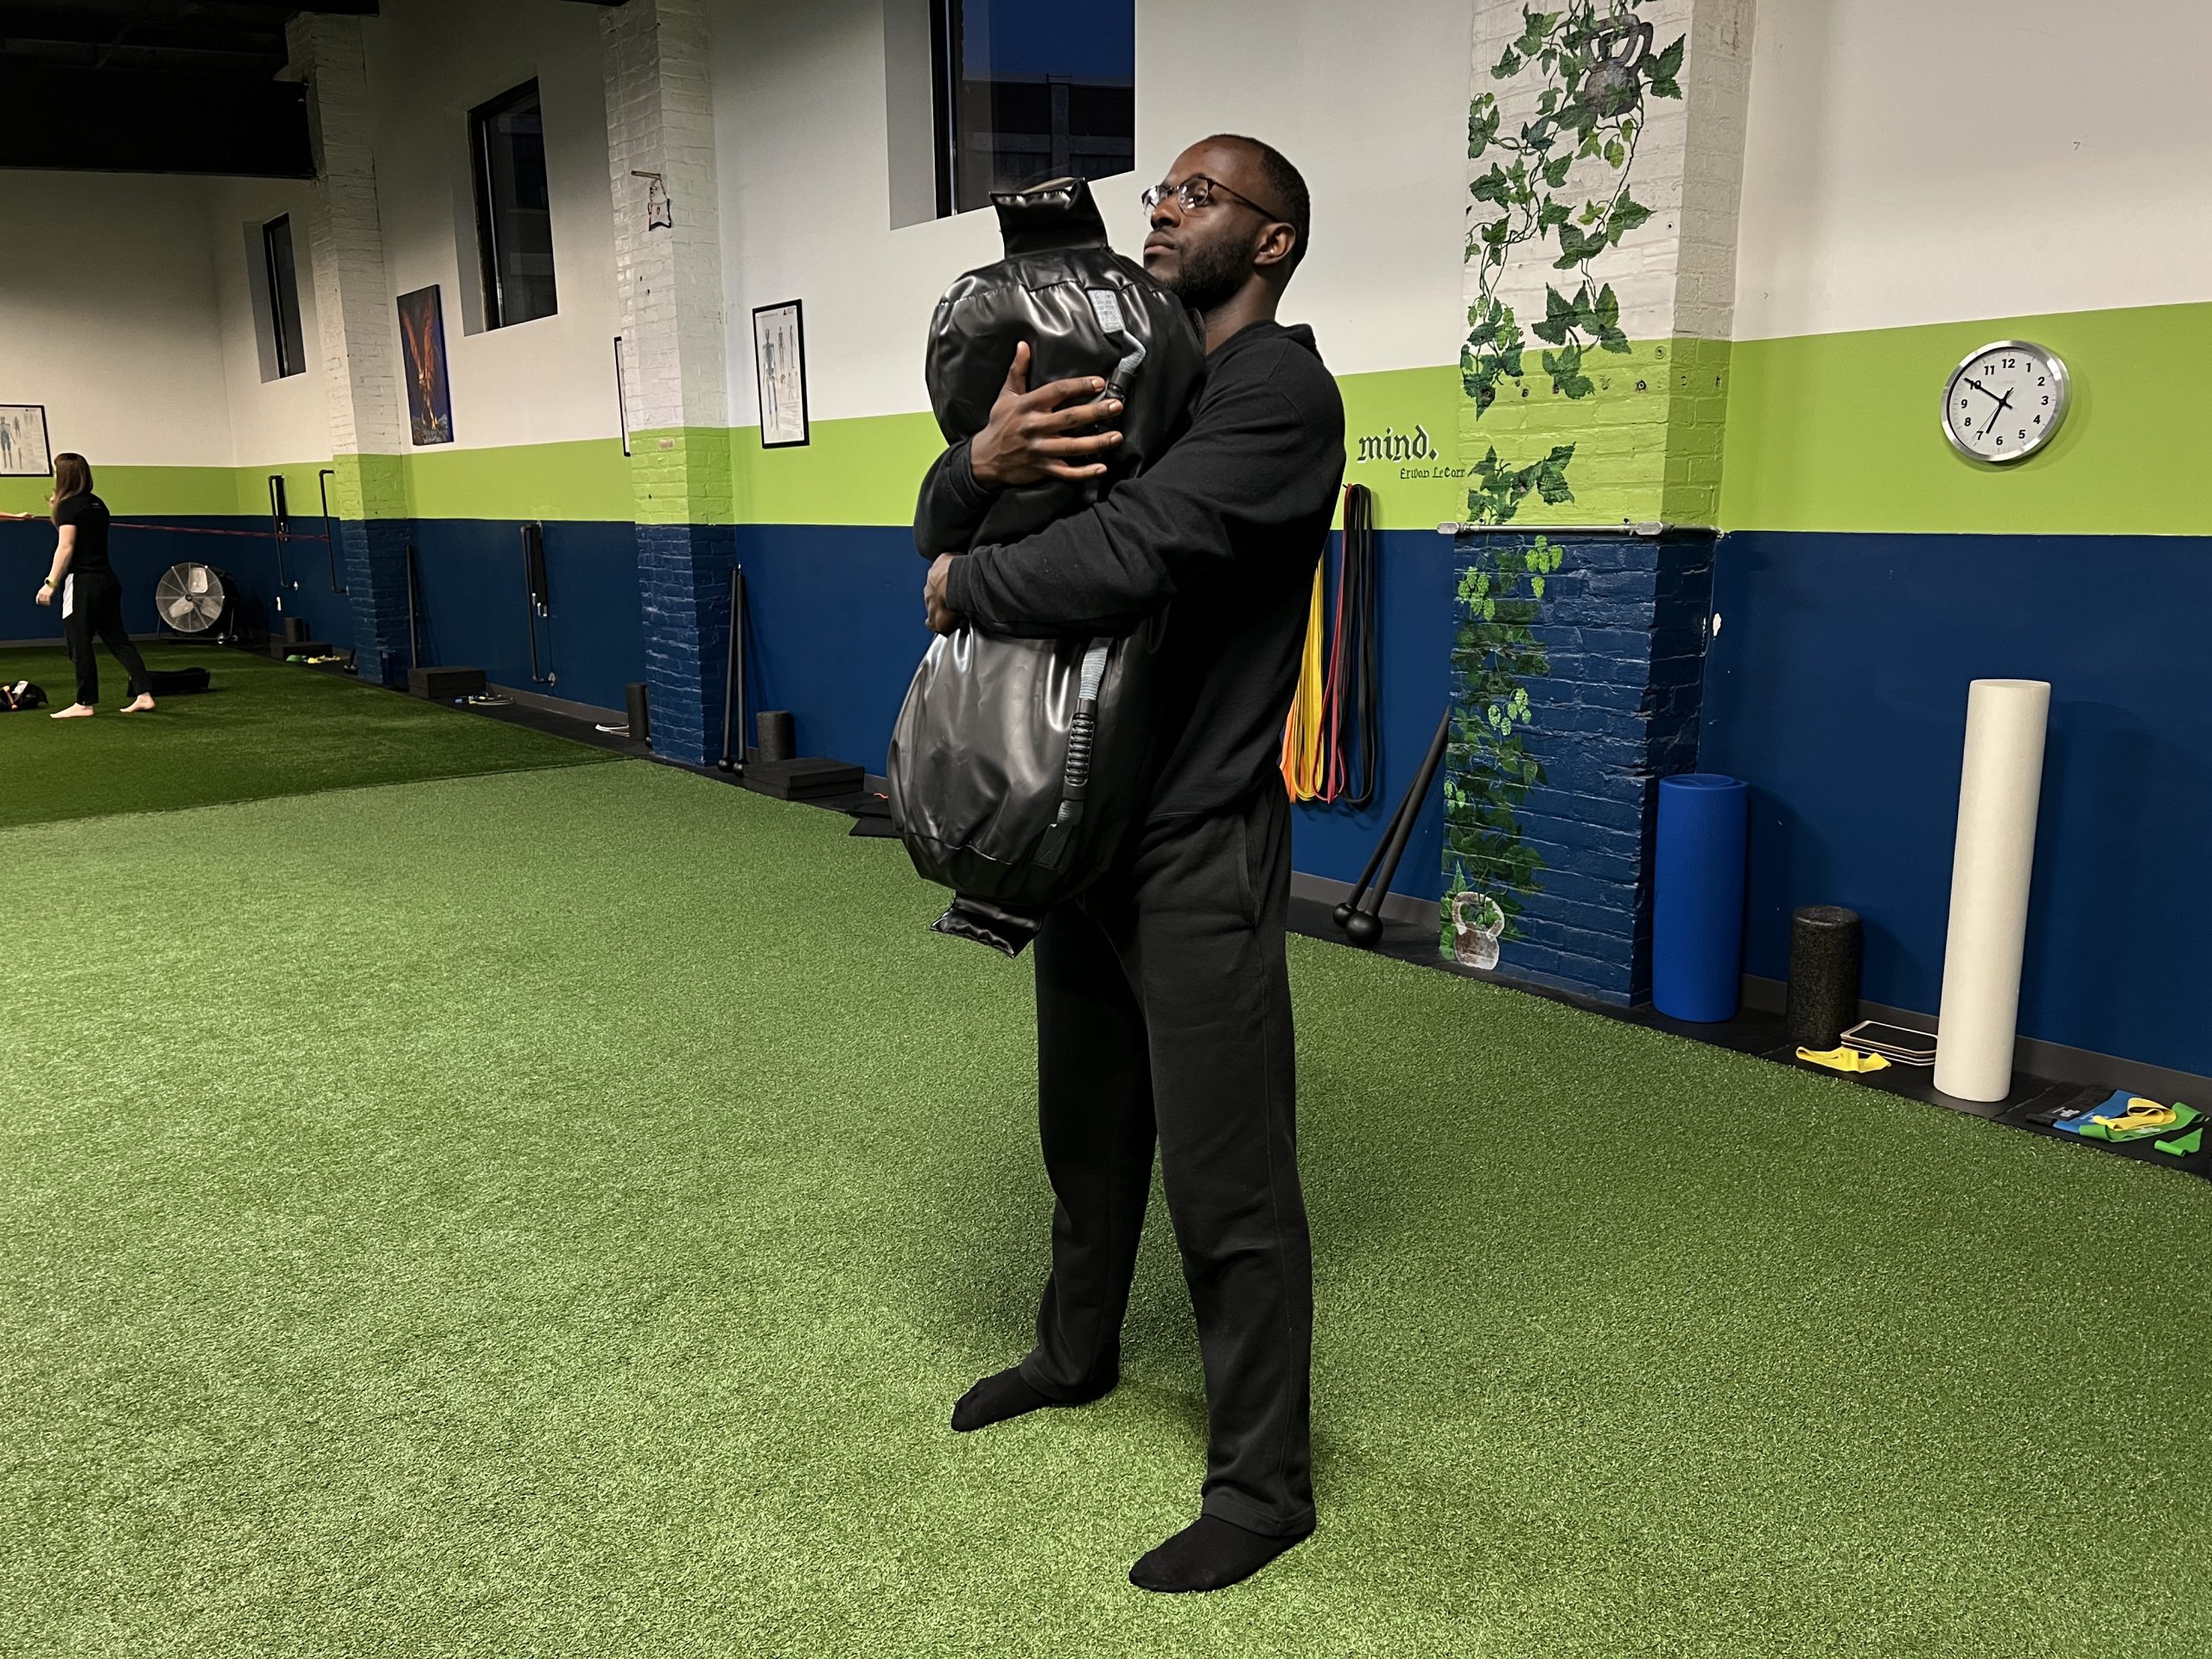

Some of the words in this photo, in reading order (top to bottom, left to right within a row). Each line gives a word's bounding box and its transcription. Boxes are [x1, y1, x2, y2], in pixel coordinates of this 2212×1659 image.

[2002, 359, 2016, 369] 12
[2026, 362, 2031, 372] 1
[1984, 365, 1995, 376] 11
[1970, 380, 1981, 390] 10
[2037, 376, 2045, 386] 2
[1961, 399, 1967, 409] 9
[2041, 395, 2049, 405] 3
[1964, 417, 1971, 427] 8
[2033, 415, 2041, 424] 4
[1976, 430, 1983, 441] 7
[2018, 429, 2025, 439] 5
[1357, 424, 1439, 463] mind.
[1996, 435, 2003, 446] 6
